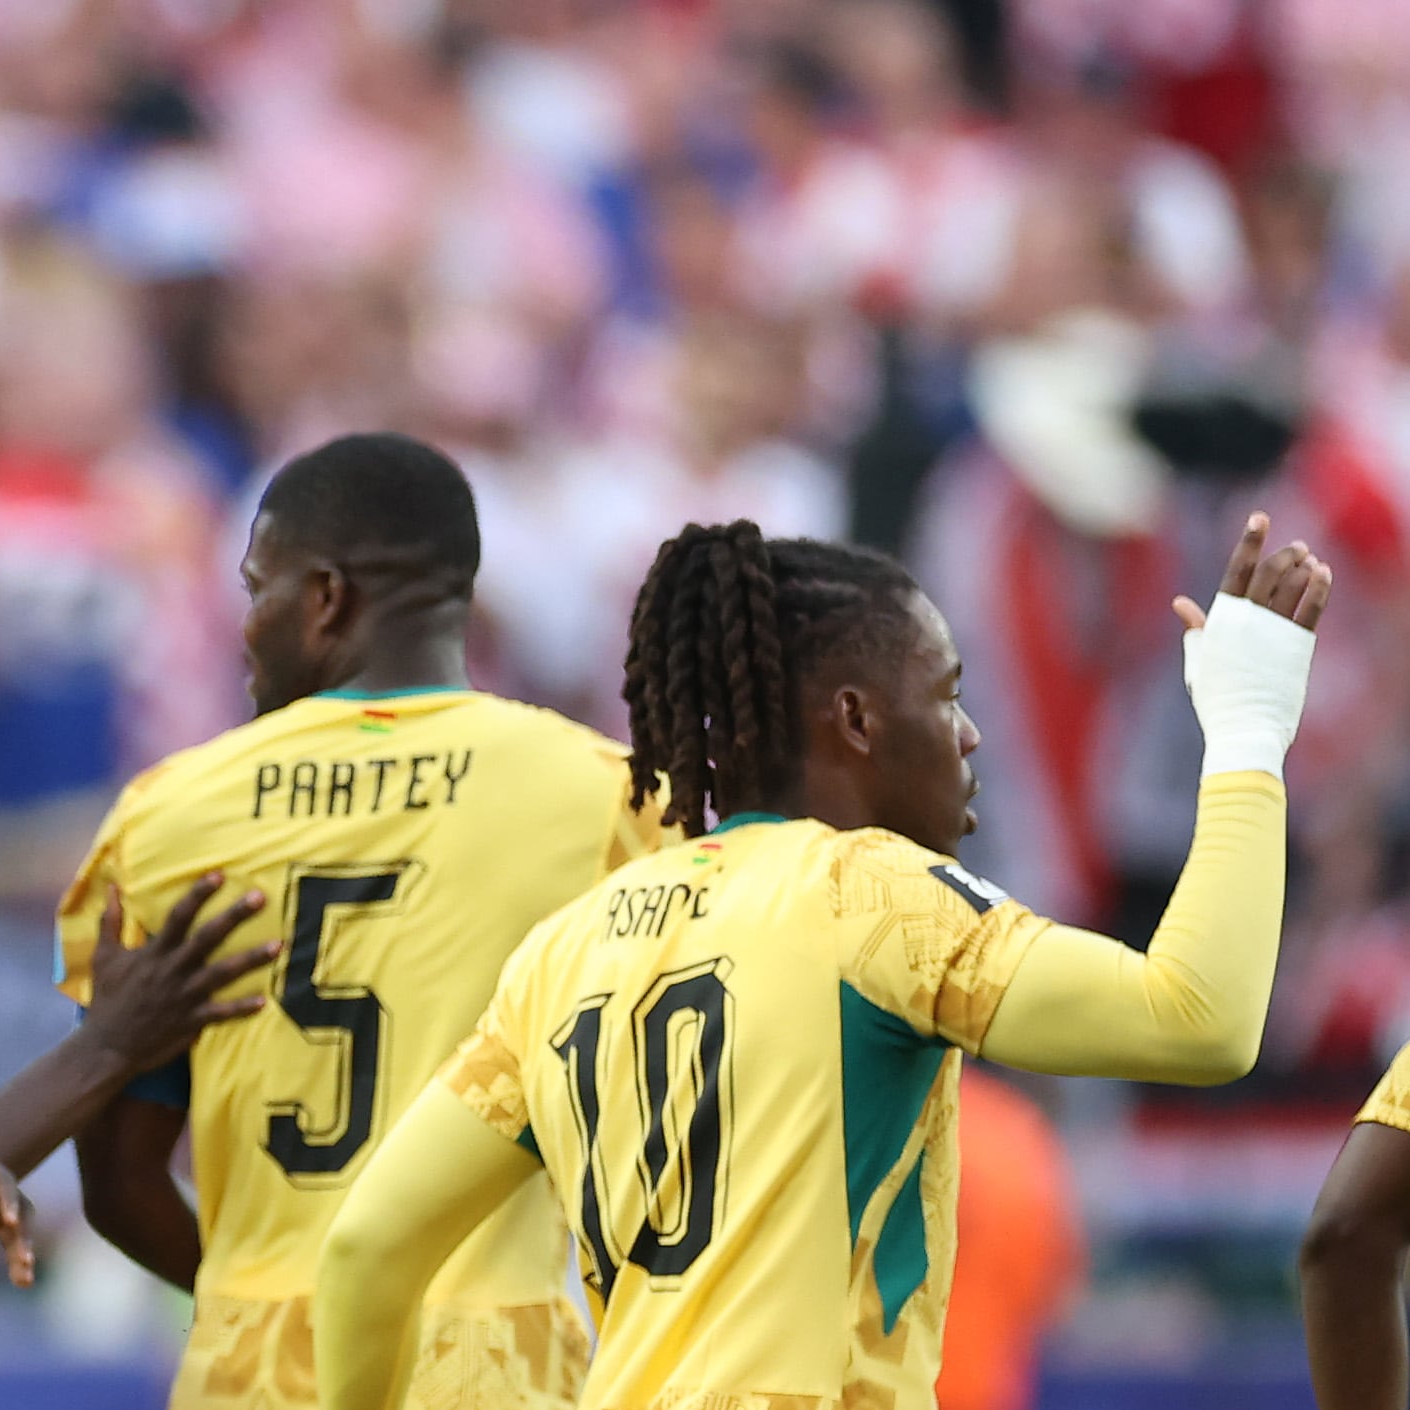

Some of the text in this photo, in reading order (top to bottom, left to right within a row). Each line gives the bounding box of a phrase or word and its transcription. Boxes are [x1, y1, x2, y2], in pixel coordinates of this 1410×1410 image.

[252, 749, 473, 819] PARTEY
[258, 859, 428, 1191] 5
[548, 955, 737, 1308] 10
